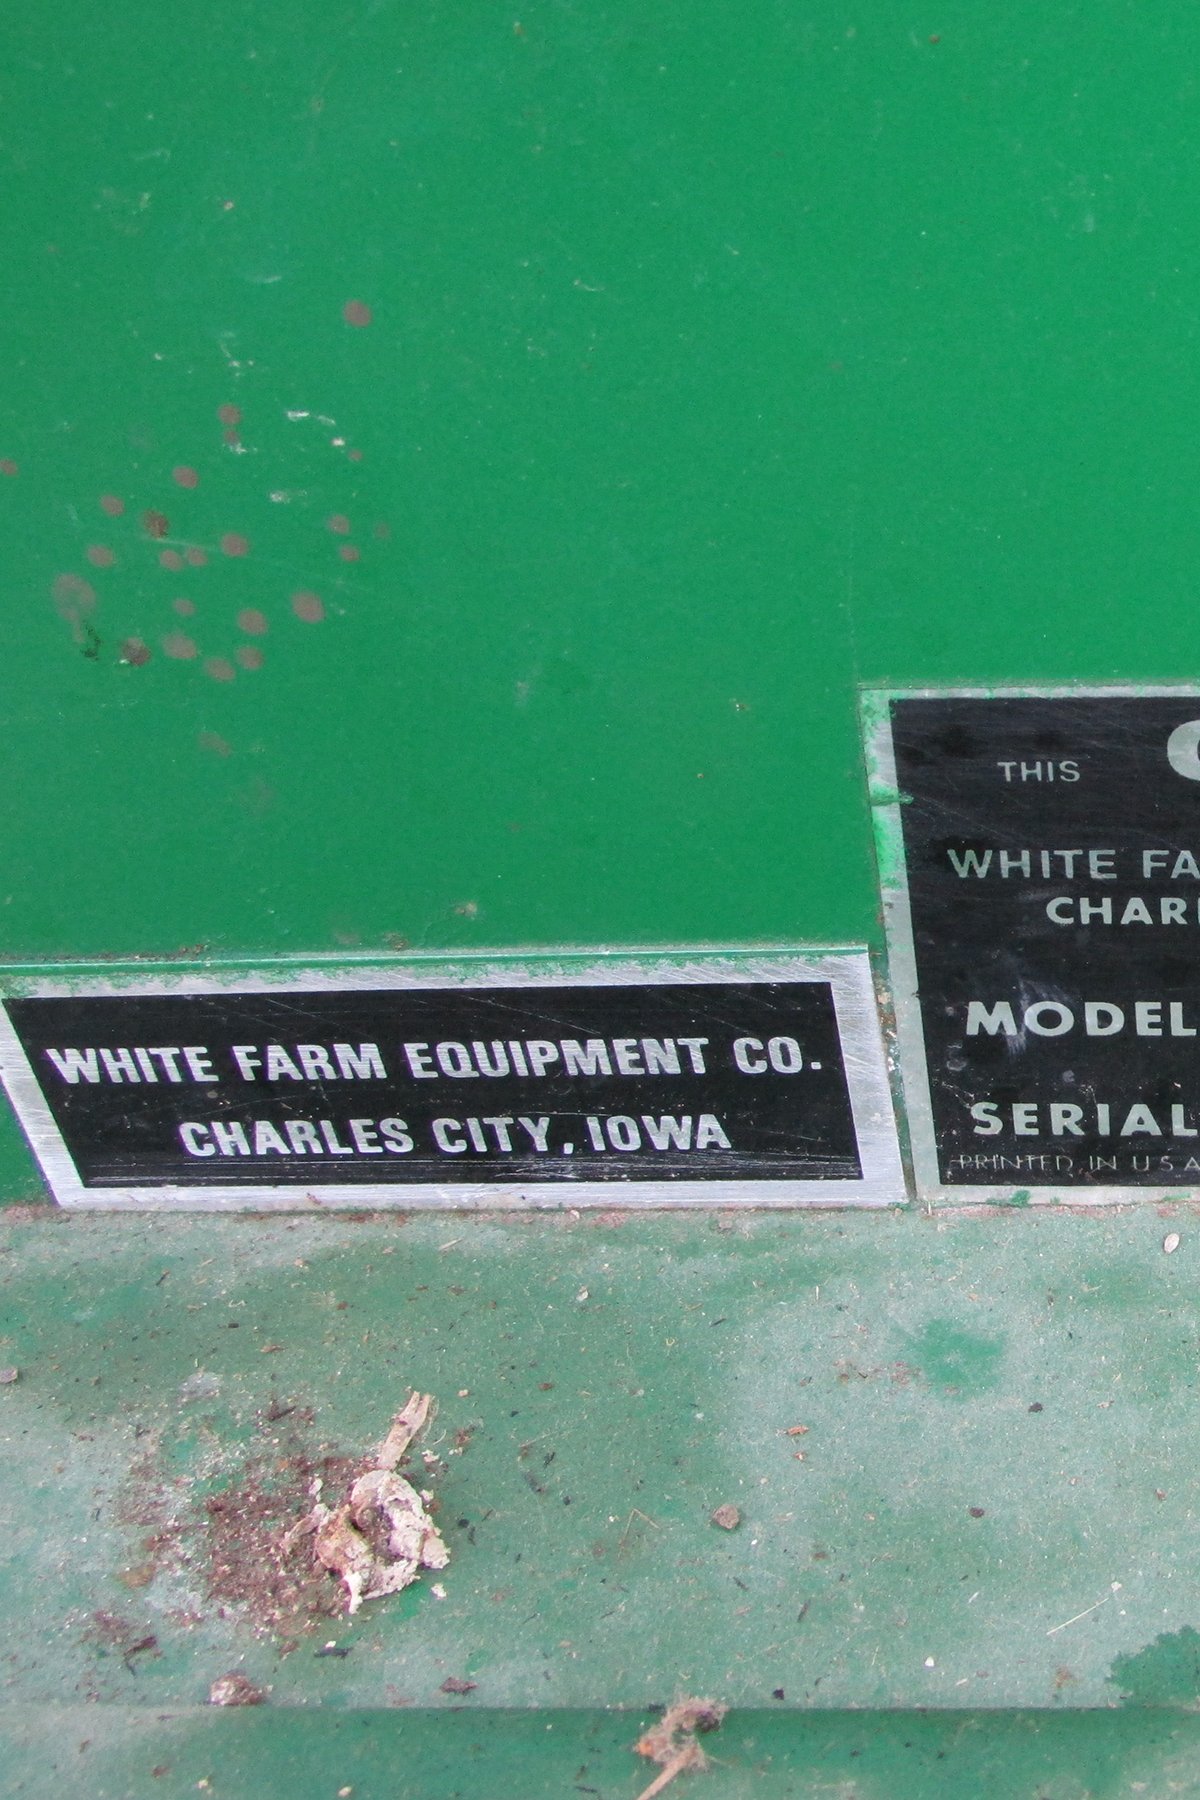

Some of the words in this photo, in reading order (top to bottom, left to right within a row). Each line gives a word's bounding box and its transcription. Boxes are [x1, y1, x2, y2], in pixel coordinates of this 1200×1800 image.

[997, 761, 1081, 782] THIS
[946, 849, 1118, 879] WHITE
[966, 1001, 1197, 1037] MODEL
[46, 1045, 219, 1084] WHITE
[233, 1043, 384, 1082] FARM
[408, 1037, 709, 1079] EQUIPMENT
[734, 1036, 823, 1075] CO.
[179, 1117, 414, 1157] CHARLES
[432, 1117, 576, 1156] CITY,
[592, 1113, 733, 1151] IOWA
[973, 1102, 1198, 1137] SERIAL
[959, 1154, 1073, 1171] PRINTED
[1090, 1154, 1117, 1170] IN
